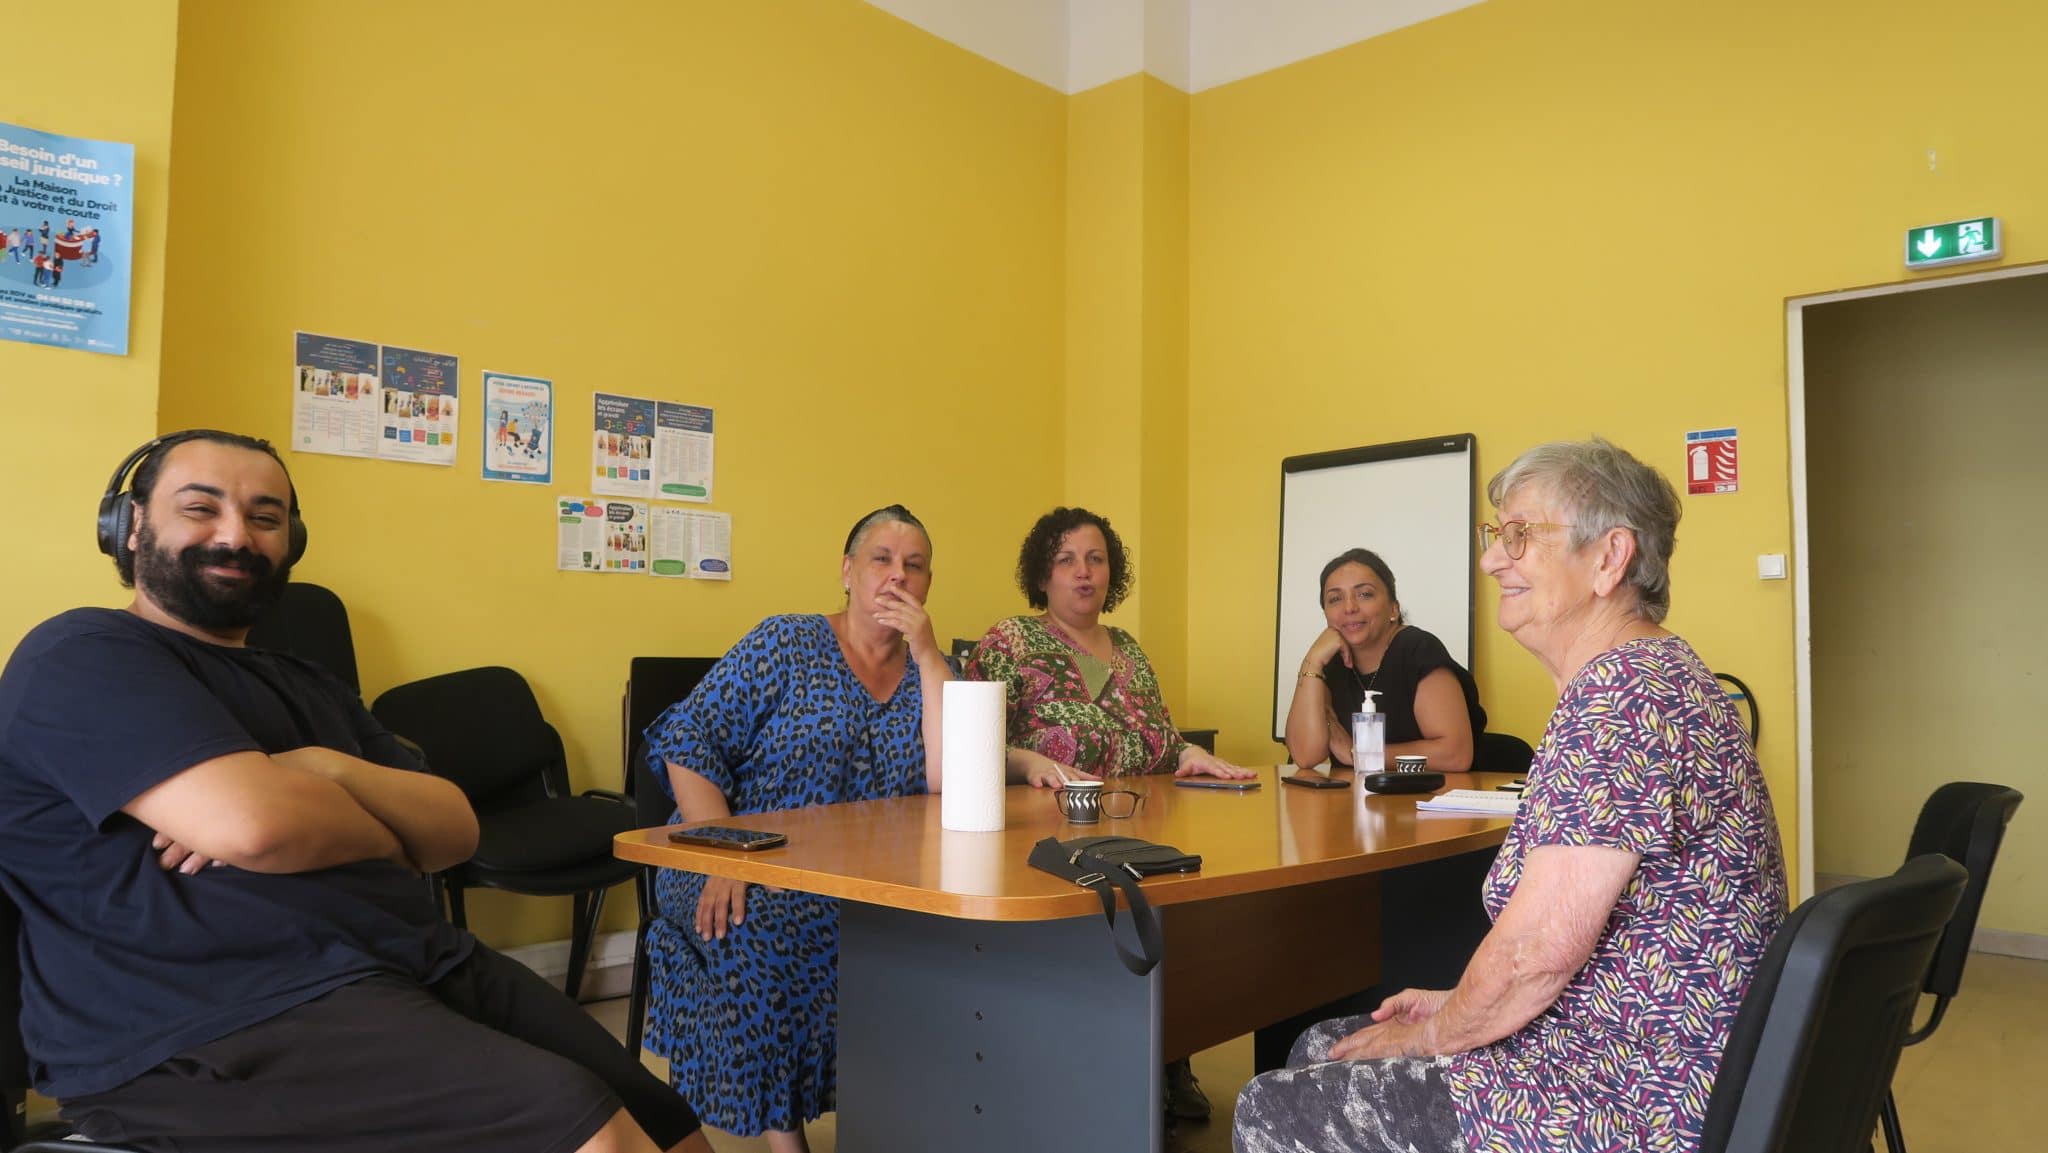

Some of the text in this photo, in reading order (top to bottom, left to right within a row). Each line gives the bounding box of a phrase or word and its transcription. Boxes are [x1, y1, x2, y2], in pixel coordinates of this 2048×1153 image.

[0, 138, 97, 169] Besoin d'un
[15, 176, 77, 196] La Maison
[32, 160, 110, 185] juridique
[112, 173, 123, 187] ?
[5, 185, 49, 201] Justice
[52, 195, 64, 204] et
[67, 197, 84, 208] du
[87, 200, 117, 212] Droit
[11, 195, 19, 206] à
[22, 199, 55, 212] votre
[58, 206, 101, 220] écoute
